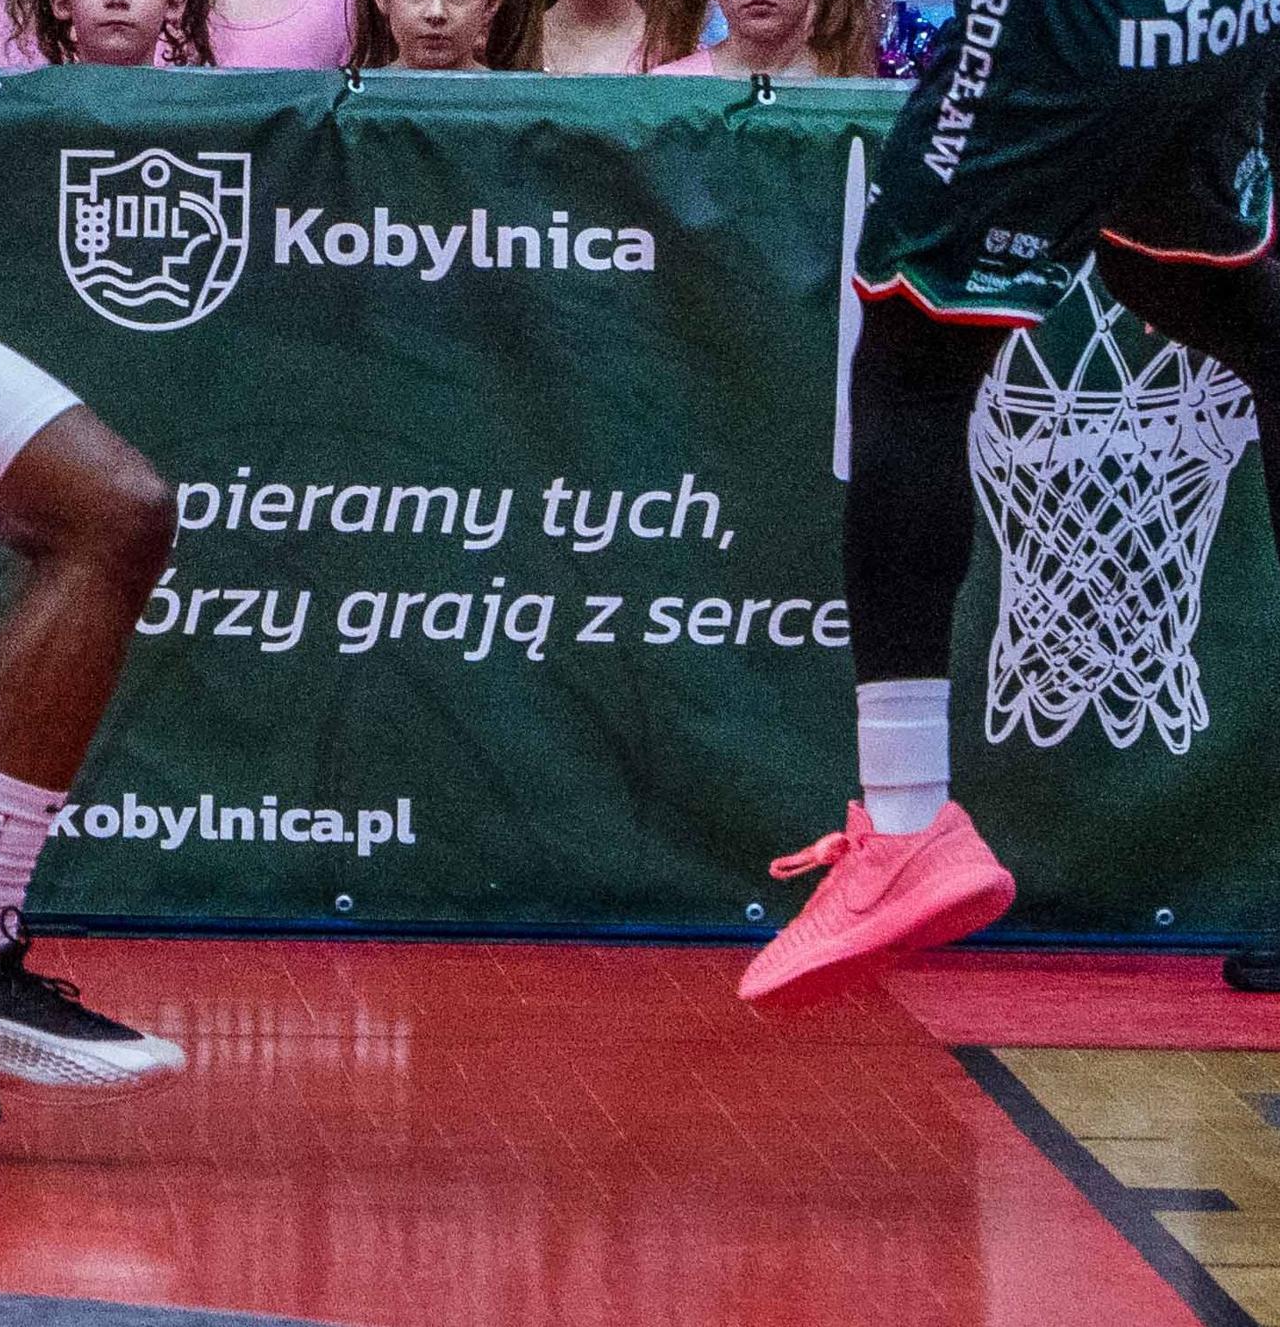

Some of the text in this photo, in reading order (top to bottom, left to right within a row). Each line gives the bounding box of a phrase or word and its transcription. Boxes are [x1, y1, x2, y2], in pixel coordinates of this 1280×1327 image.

[275, 206, 657, 281] Kobylnica
[174, 466, 736, 551] pieramy tych,
[135, 568, 851, 662] órzy grają z serce
